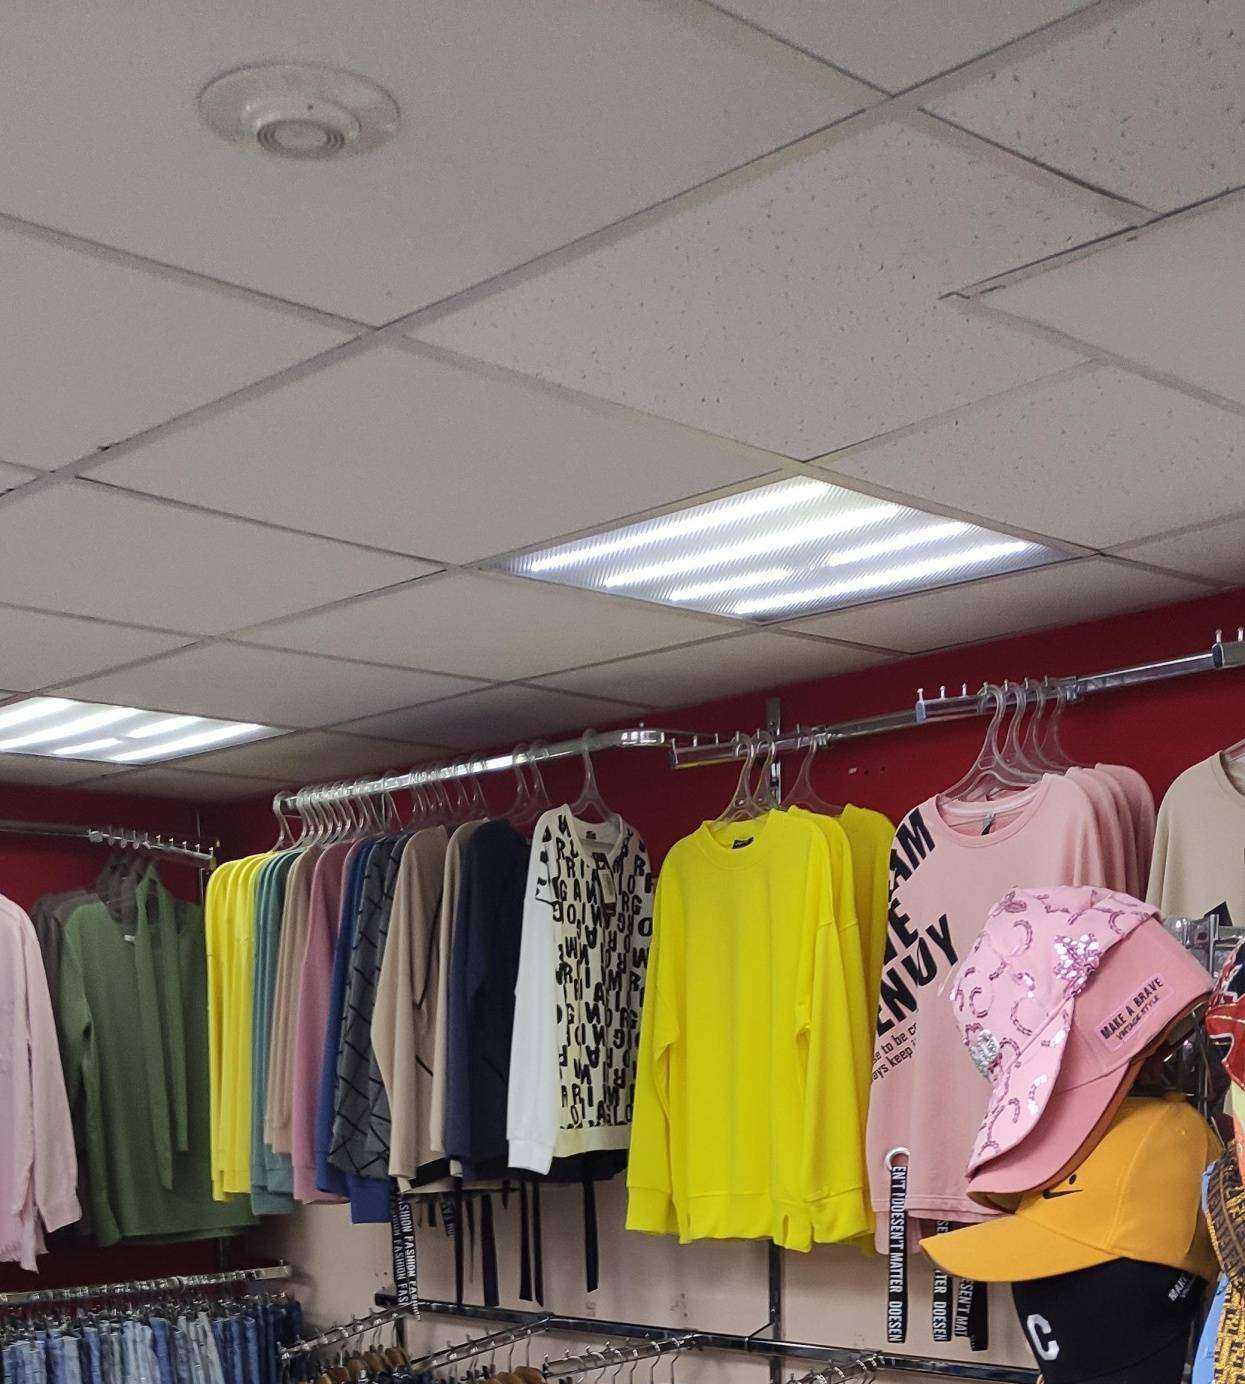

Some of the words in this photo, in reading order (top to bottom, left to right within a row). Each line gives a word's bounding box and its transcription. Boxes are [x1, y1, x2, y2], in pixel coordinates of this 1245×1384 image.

[1100, 1012, 1127, 1039] MAKE
[1125, 1005, 1135, 1017] A
[1133, 977, 1164, 1007] BRAVE
[881, 1041, 894, 1056] to
[895, 1031, 908, 1047] be
[889, 1046, 914, 1068] keep
[404, 1235, 417, 1277] FASHION
[889, 1252, 904, 1293] MATTER
[1027, 1313, 1060, 1361] C
